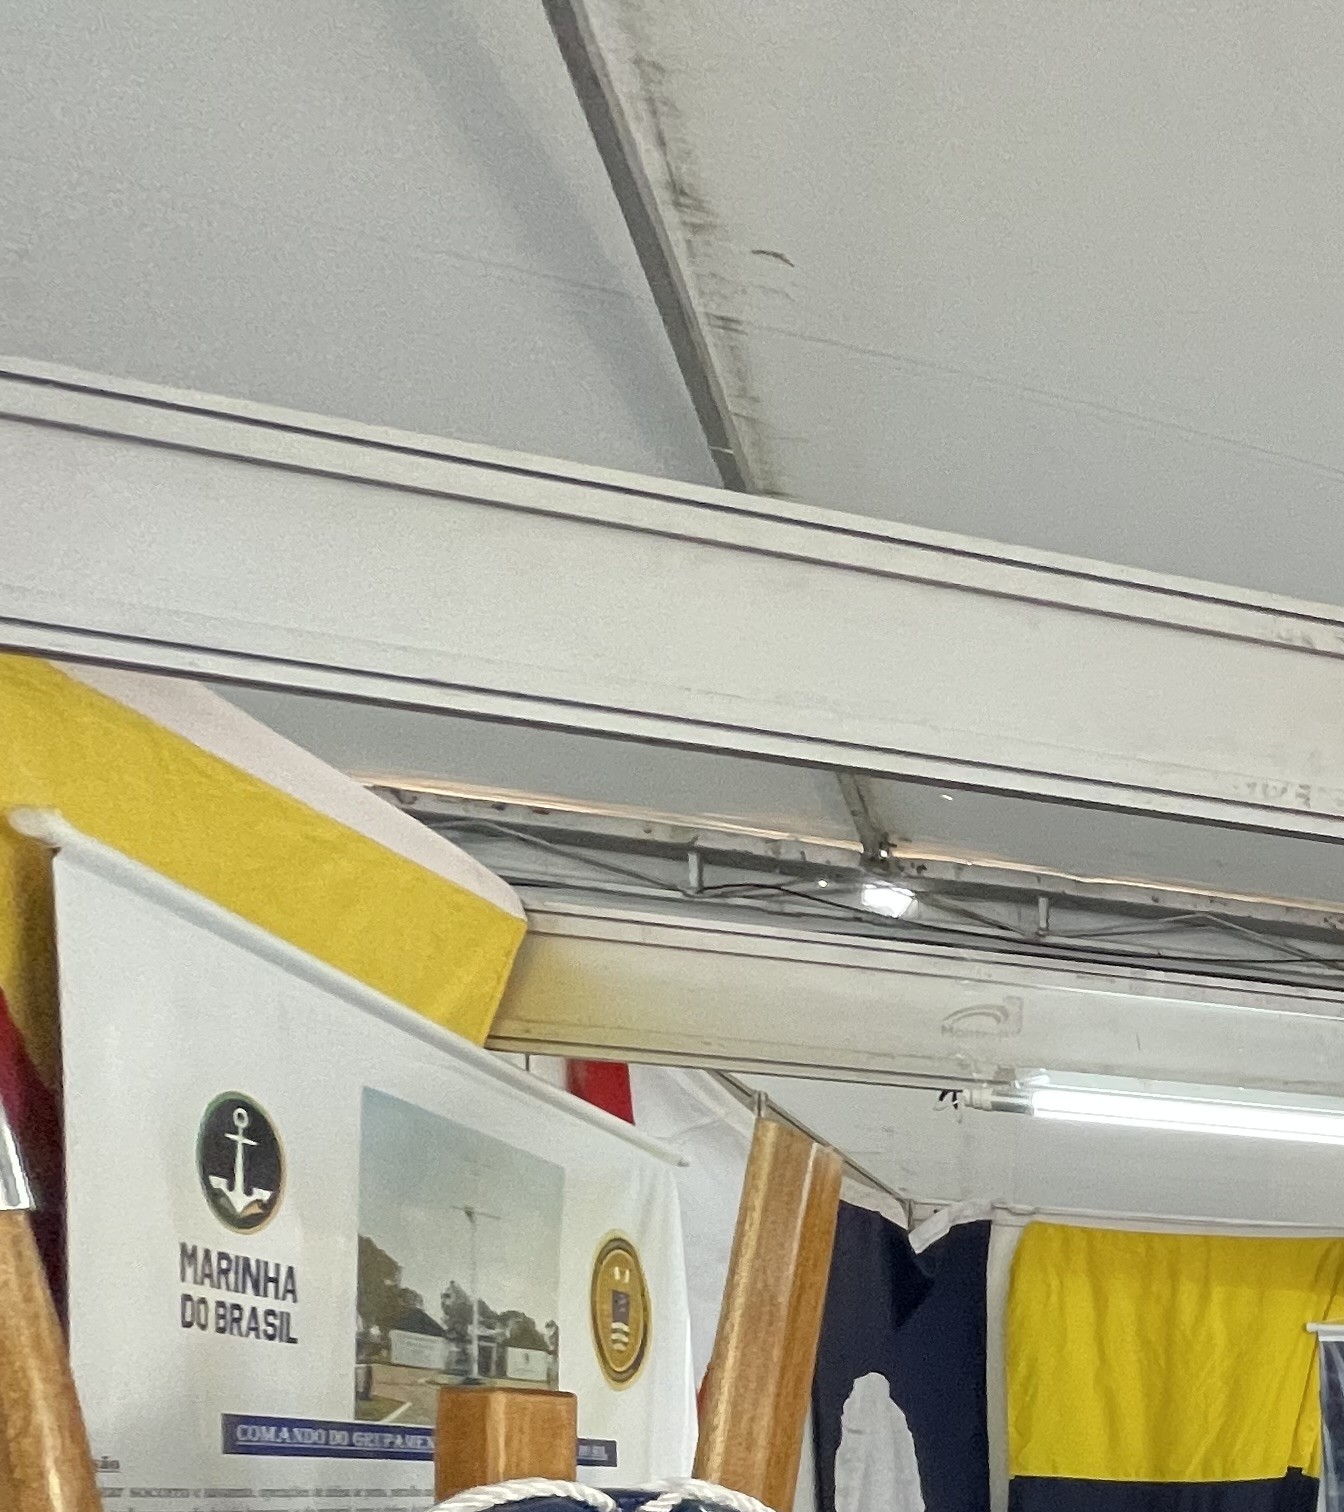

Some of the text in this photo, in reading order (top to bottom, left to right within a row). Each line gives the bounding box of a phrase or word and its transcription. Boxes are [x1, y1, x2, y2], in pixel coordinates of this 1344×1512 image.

[180, 1242, 298, 1303] MARINHA
[181, 1293, 298, 1344] DO BRASIL
[236, 1424, 325, 1444] COMANDO
[329, 1430, 349, 1446] DO
[353, 1432, 435, 1450] GRUPAMEN
